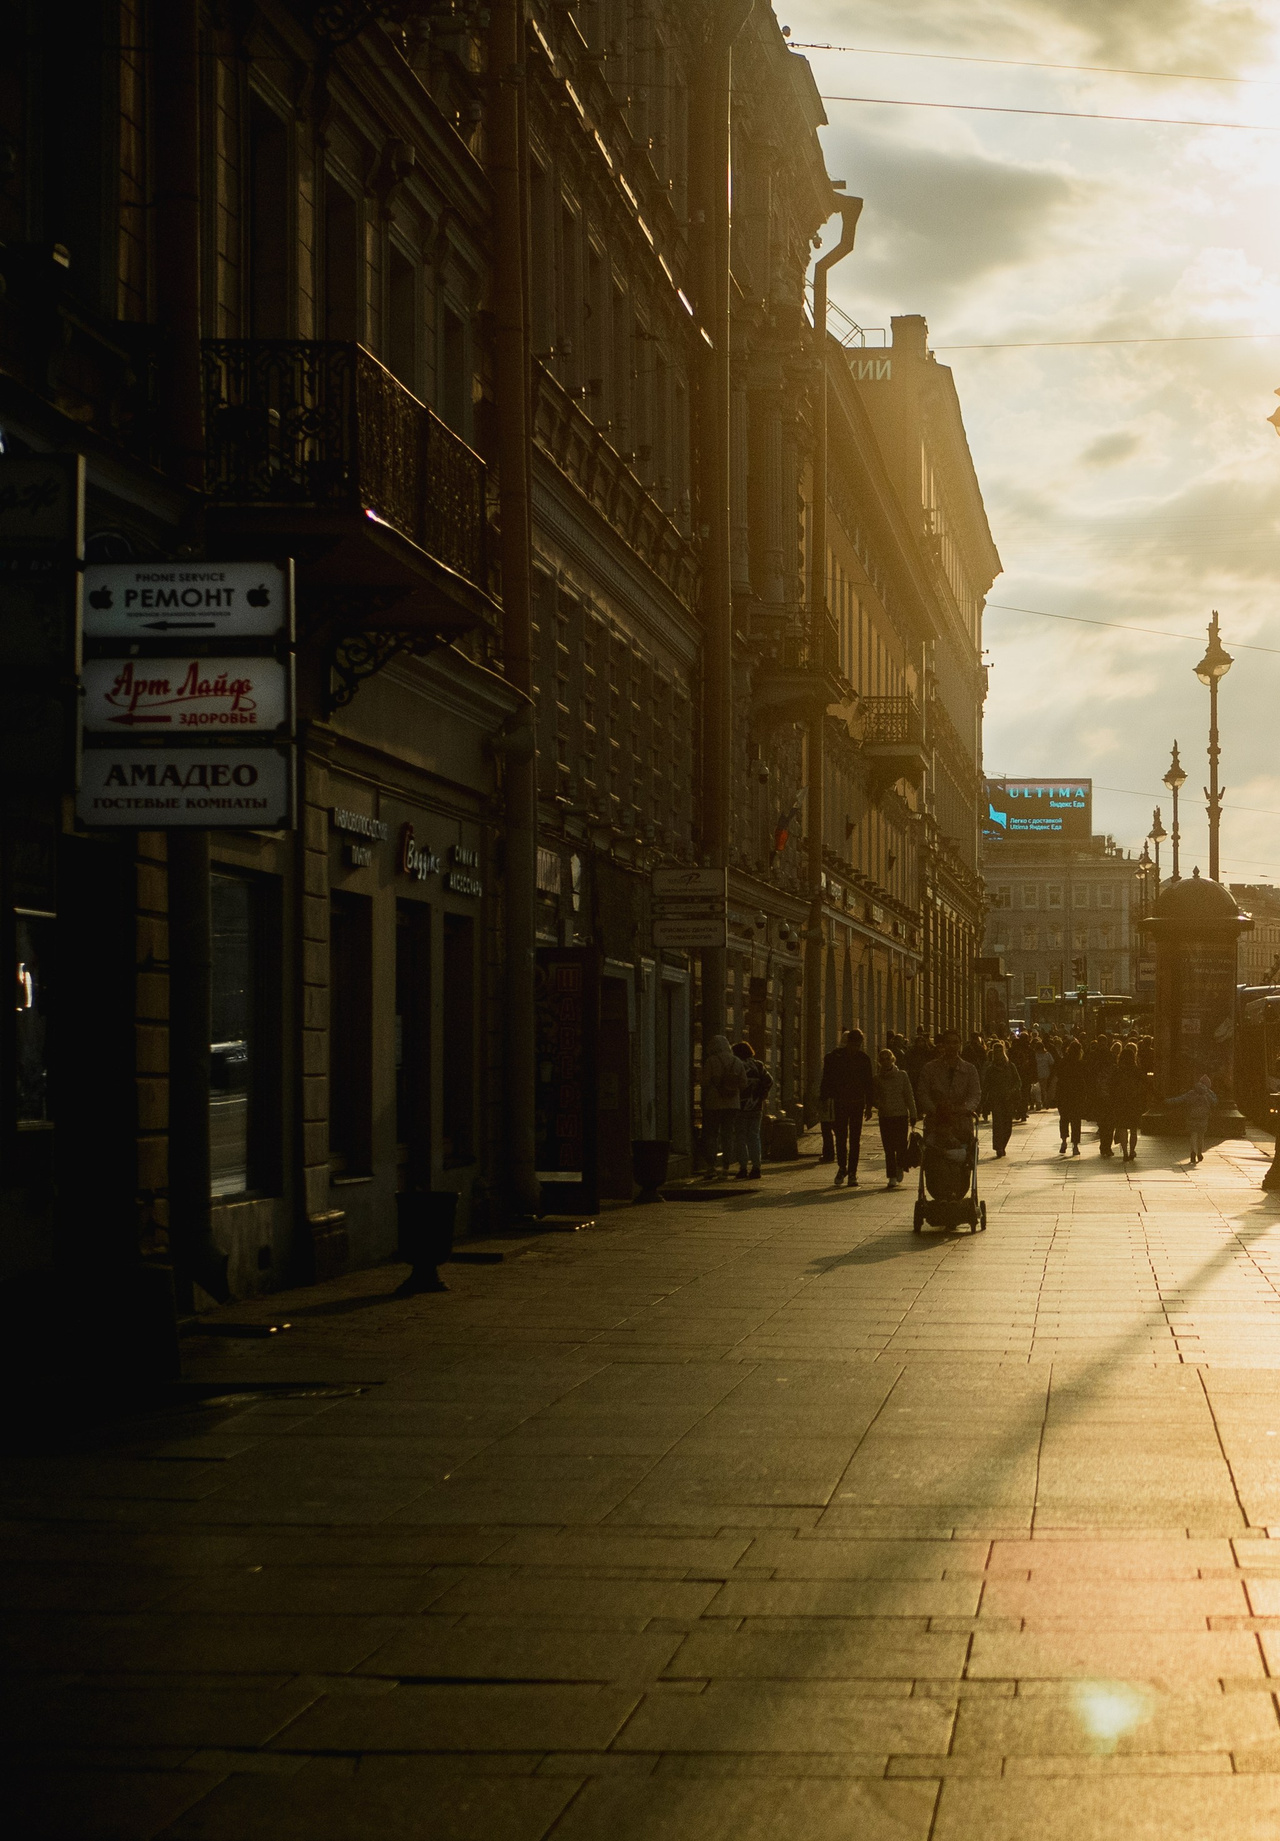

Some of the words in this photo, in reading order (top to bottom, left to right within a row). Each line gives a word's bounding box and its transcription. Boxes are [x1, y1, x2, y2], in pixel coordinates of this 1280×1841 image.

[135, 572, 176, 583] PHONE
[178, 572, 226, 582] SERVICE
[124, 588, 235, 608] РЕМОНТ
[111, 661, 172, 712] Арт
[176, 661, 257, 712] Лайф
[178, 713, 258, 726] ЗДОРОВЬЕ
[103, 763, 259, 791] АМАДЕО
[1008, 787, 1086, 798] ULTIMA
[92, 797, 181, 809] ГОСТЕВЫЕ
[185, 797, 268, 809] КОМНАТЫ
[1049, 800, 1073, 808] Яндекс
[1073, 800, 1086, 808] Еда
[406, 839, 441, 881] Baggins
[556, 968, 580, 1167] ШАВЕРМА
